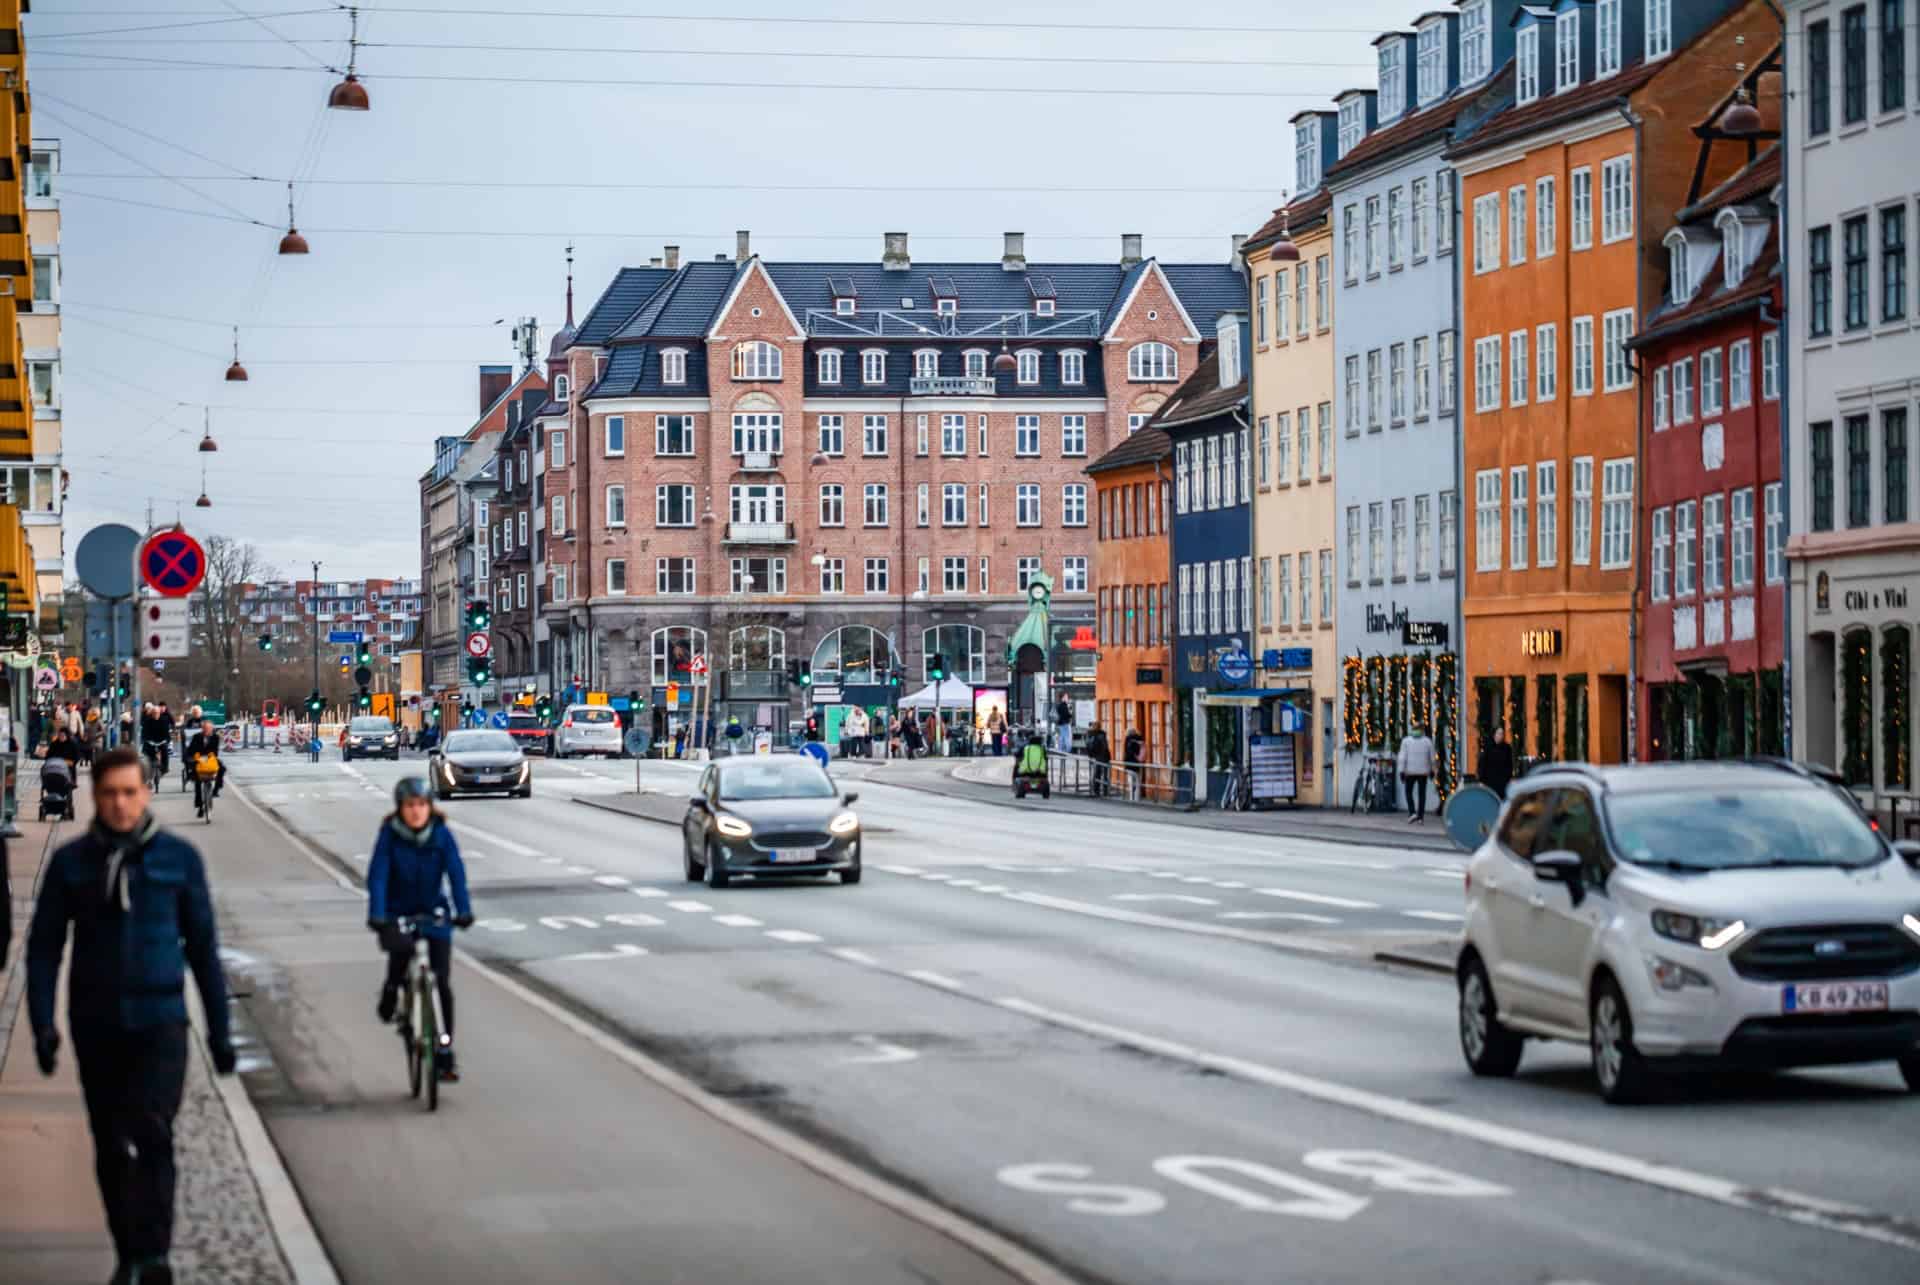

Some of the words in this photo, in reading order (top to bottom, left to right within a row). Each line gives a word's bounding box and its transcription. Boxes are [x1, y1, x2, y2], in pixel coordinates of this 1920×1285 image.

[1366, 602, 1386, 633] Hair
[1409, 623, 1433, 634] Hair
[1521, 630, 1555, 657] HENRI
